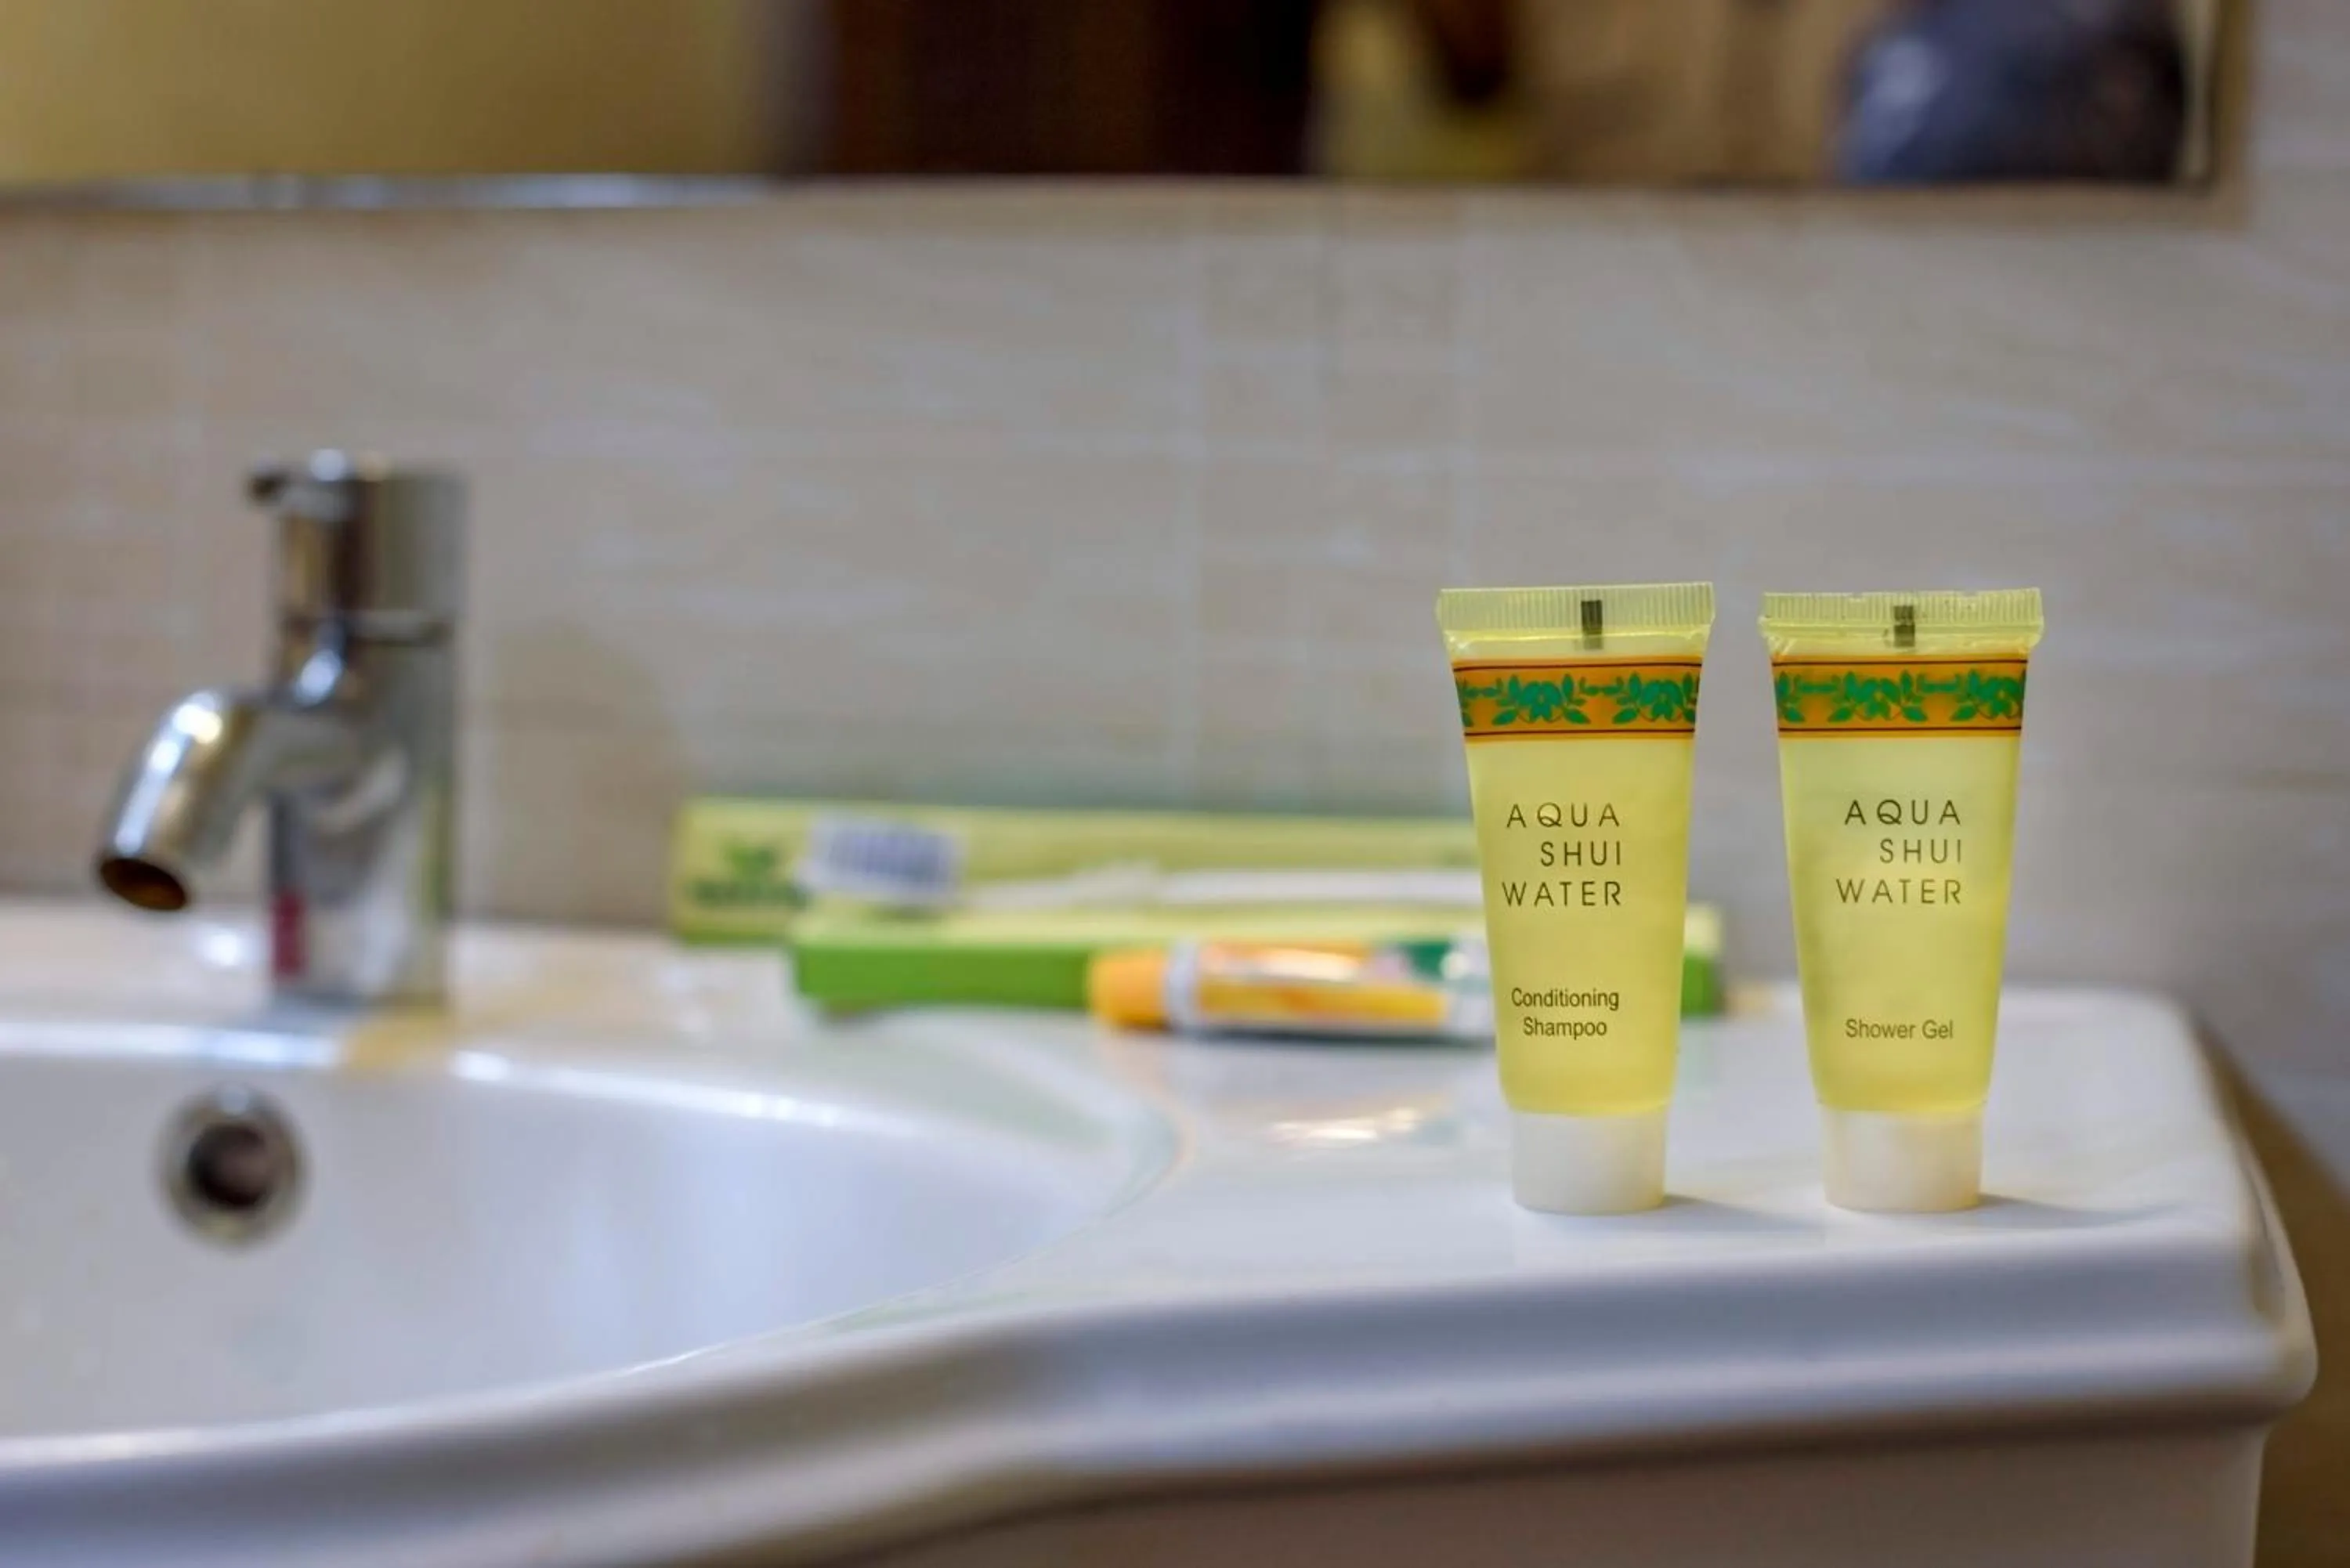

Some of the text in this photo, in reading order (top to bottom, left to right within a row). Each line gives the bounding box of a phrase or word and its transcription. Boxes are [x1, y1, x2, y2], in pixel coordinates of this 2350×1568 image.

[1506, 801, 1620, 828] AQUA
[1844, 798, 1961, 826] AQUA
[1540, 840, 1621, 867] SHUI
[1879, 837, 1961, 864] SHUI
[1502, 880, 1622, 907] WATER
[1835, 878, 1961, 905] WATER
[1511, 987, 1620, 1011] Conditioning
[1523, 1016, 1607, 1040] Shampoo
[1845, 1018, 1954, 1040] Shower Gel
